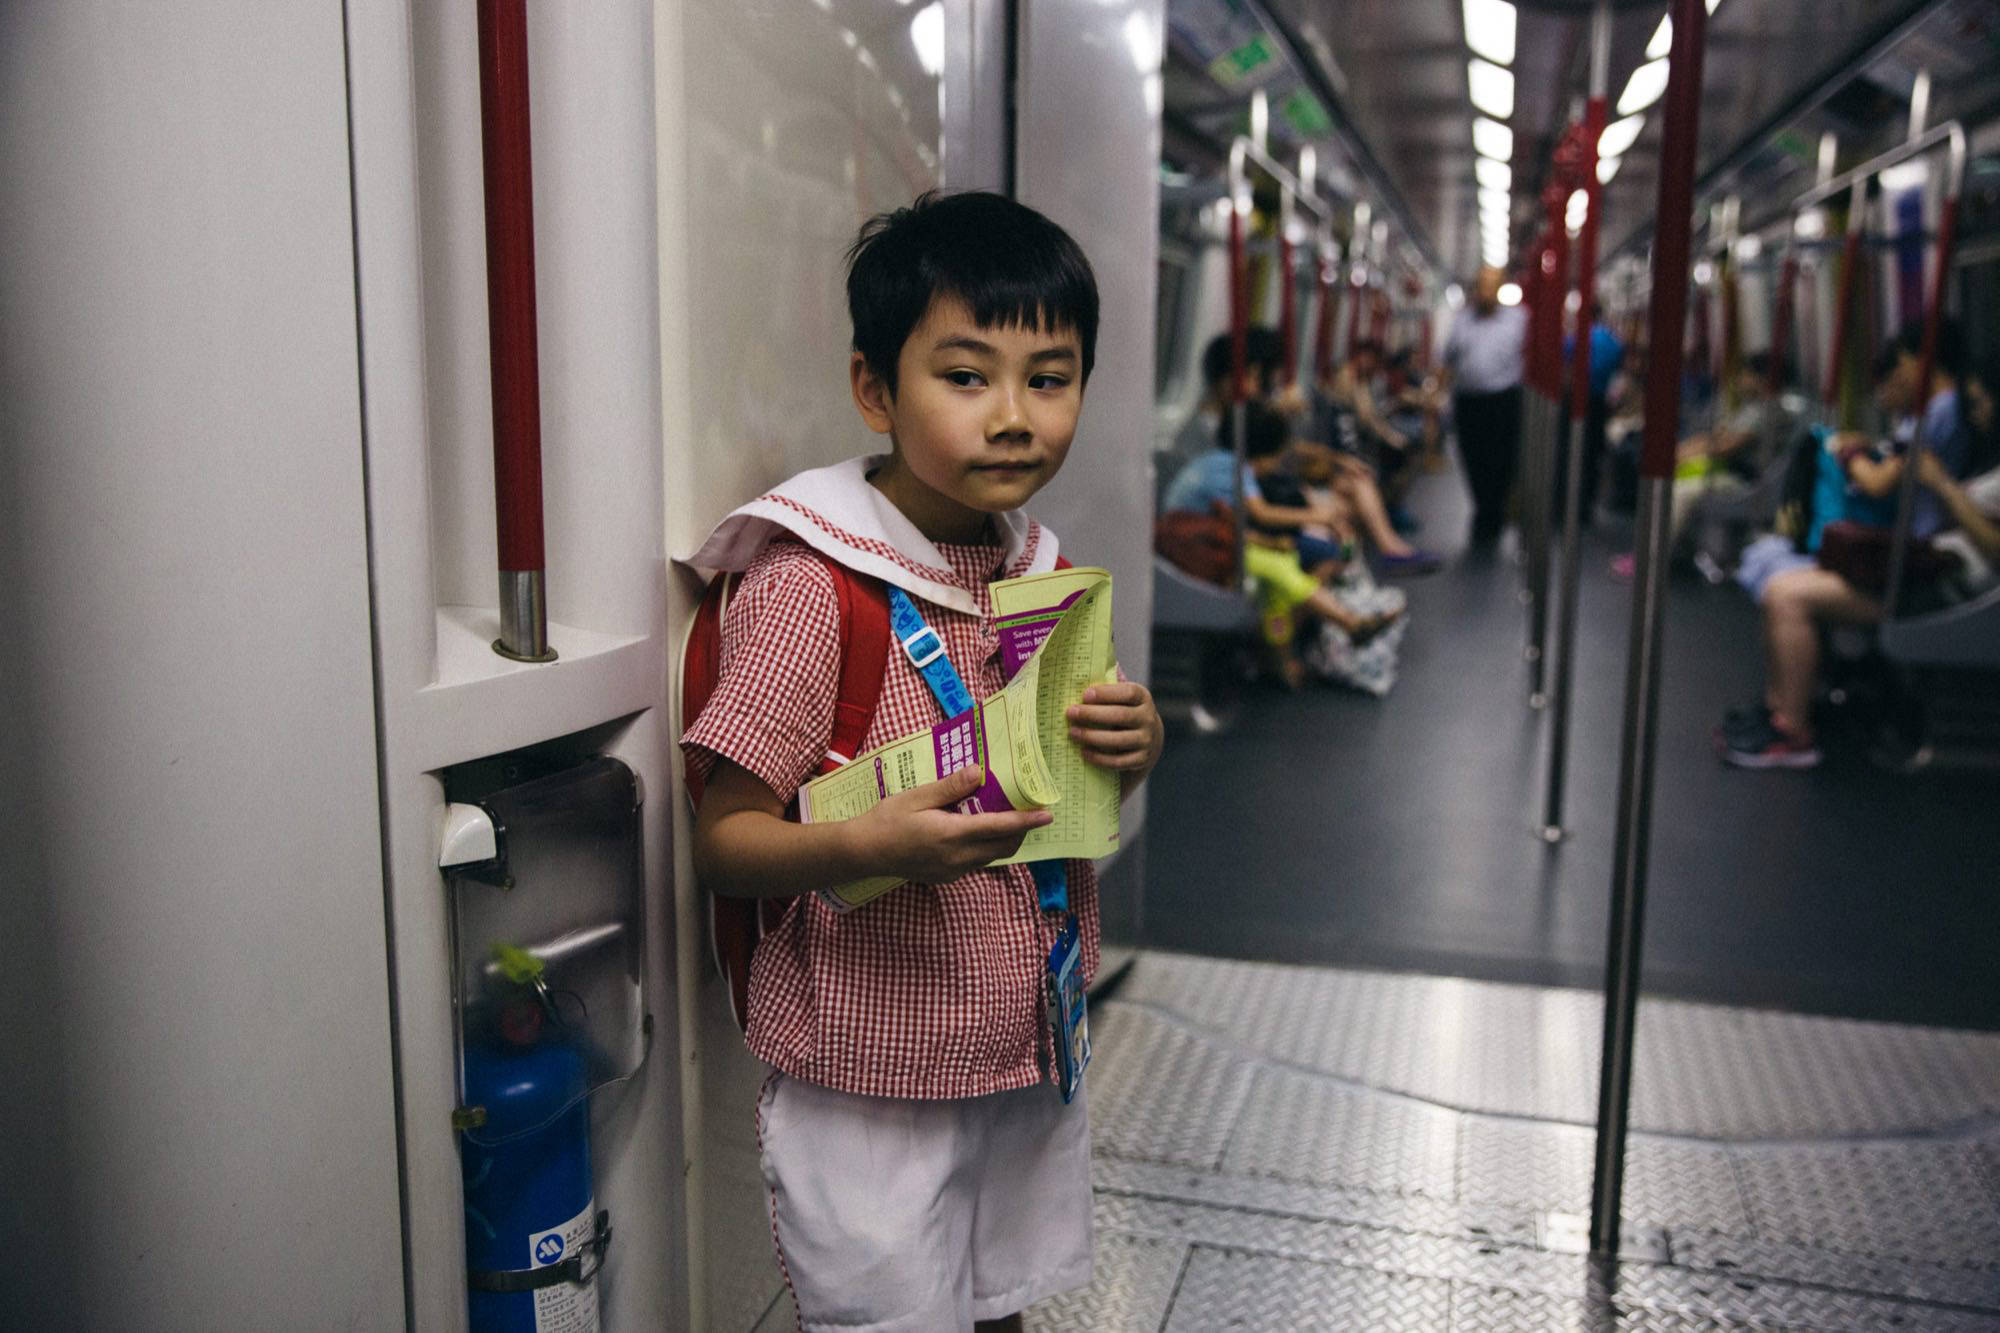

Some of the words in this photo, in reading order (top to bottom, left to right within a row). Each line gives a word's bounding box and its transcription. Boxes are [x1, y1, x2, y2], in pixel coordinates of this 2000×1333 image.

[1013, 630, 1031, 640] Save
[1015, 639, 1033, 650] with
[1034, 636, 1047, 646] MT
[1018, 651, 1033, 661] int
